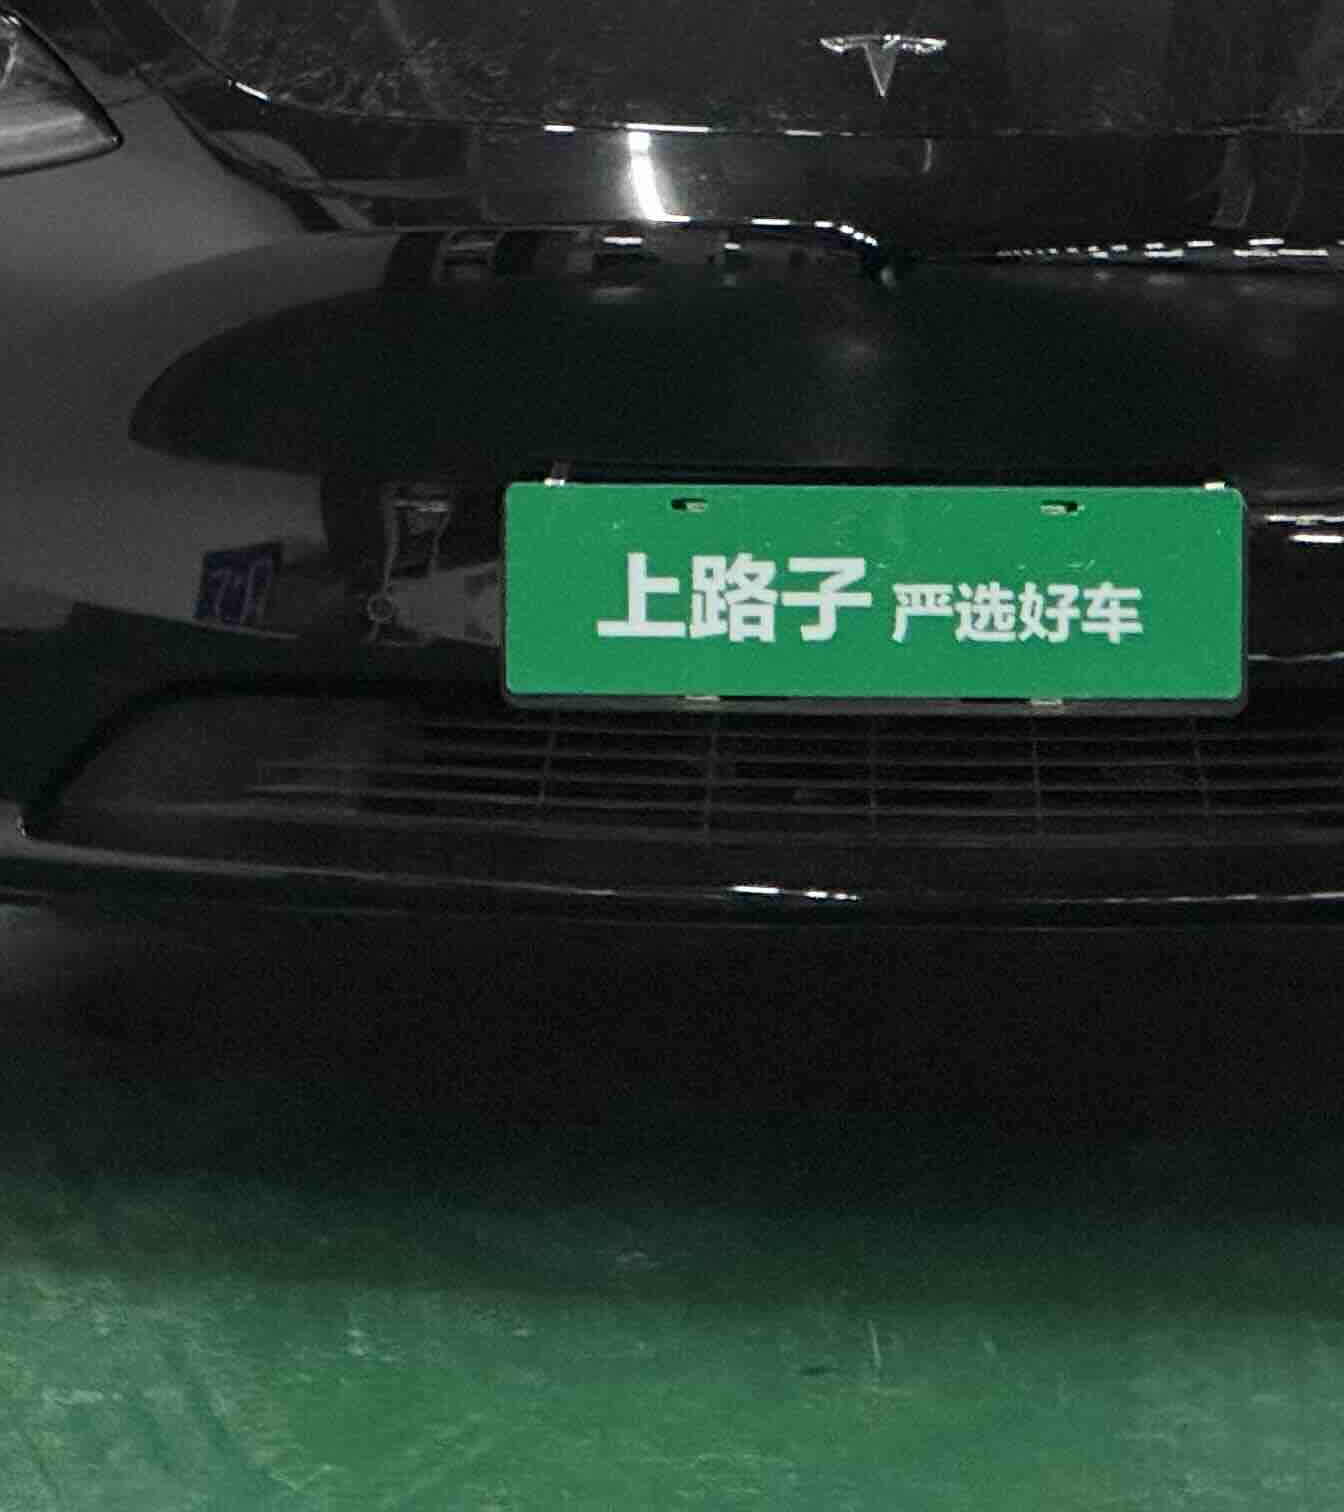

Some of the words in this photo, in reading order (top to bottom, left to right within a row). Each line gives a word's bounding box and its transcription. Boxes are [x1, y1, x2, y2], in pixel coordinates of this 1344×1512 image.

[596, 551, 873, 644] 上路子
[892, 582, 1144, 644] 严选好车
